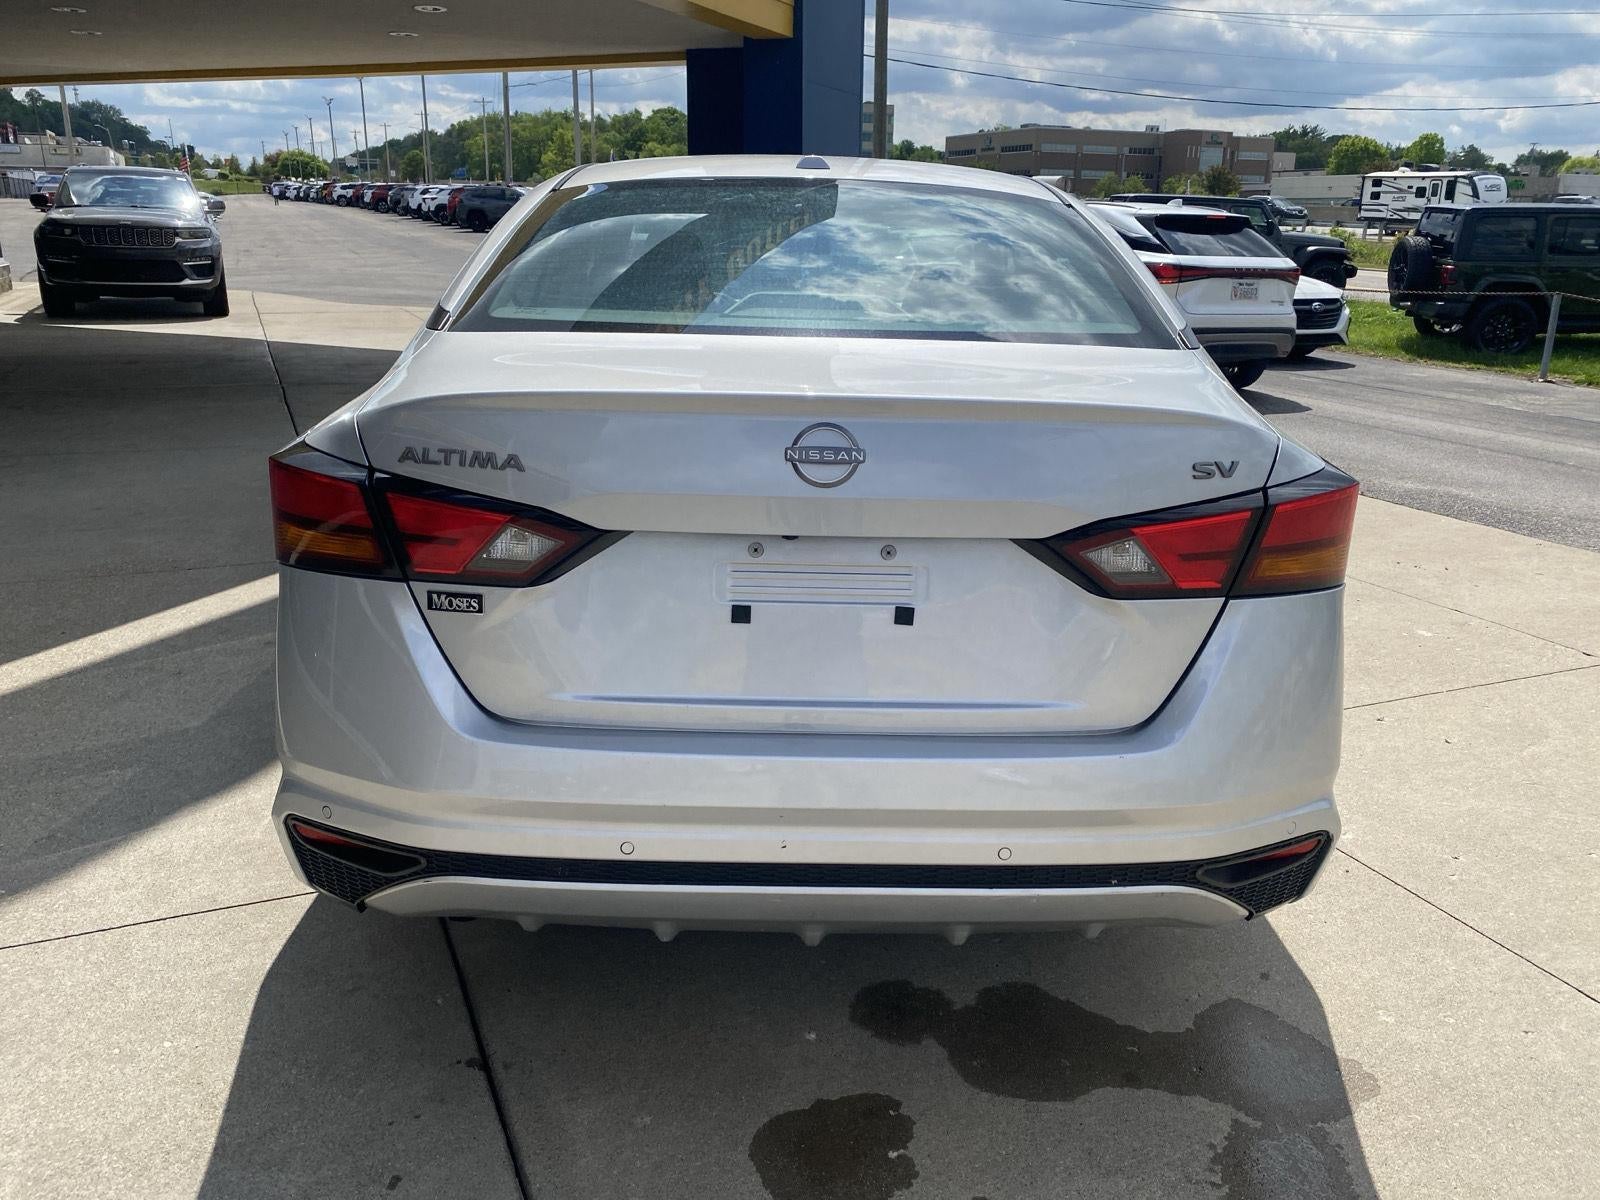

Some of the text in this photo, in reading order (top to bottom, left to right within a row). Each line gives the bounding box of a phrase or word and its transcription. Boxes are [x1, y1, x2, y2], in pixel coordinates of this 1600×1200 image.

[397, 446, 526, 473] ALTIMA
[787, 449, 864, 461] NISSAN
[1192, 461, 1239, 480] SV
[431, 593, 479, 611] MOSES
